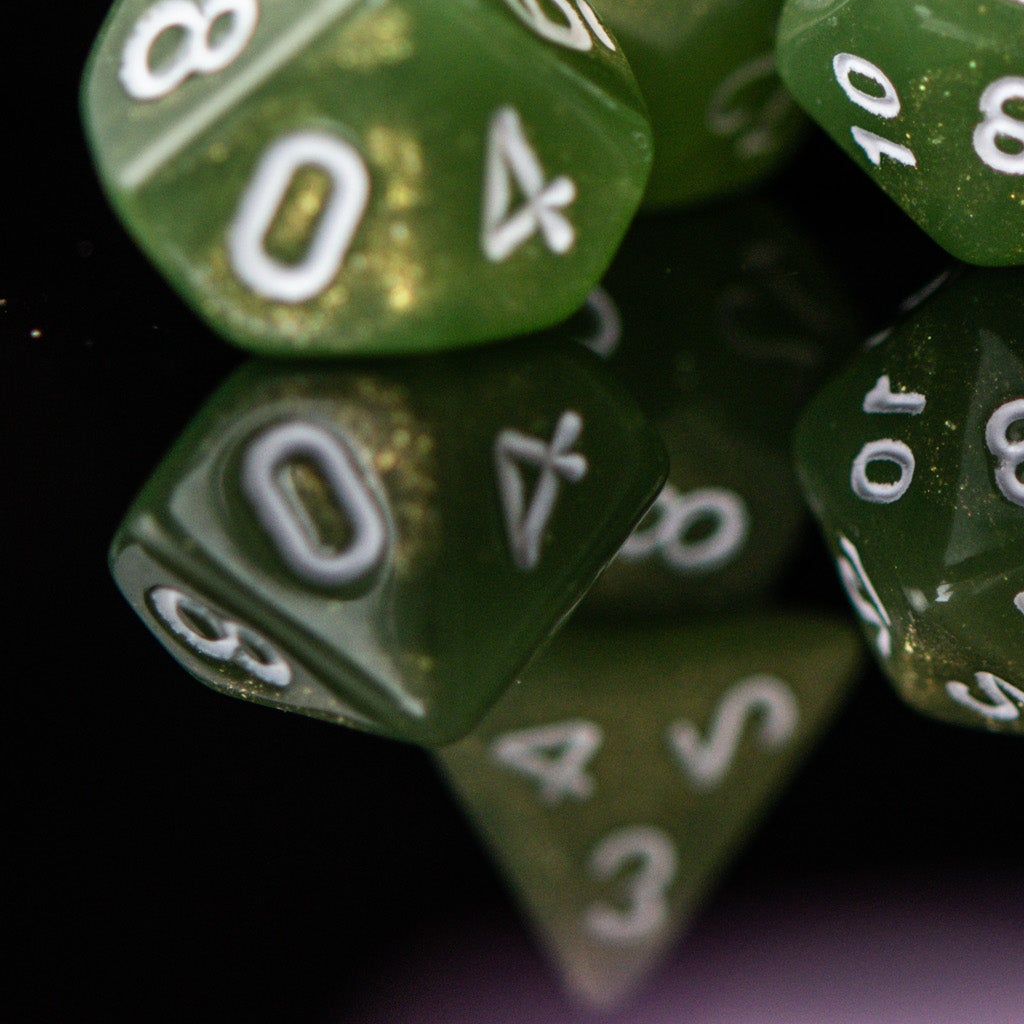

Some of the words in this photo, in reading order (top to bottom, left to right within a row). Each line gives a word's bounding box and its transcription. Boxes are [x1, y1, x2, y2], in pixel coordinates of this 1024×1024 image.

[482, 107, 577, 263] 4
[832, 51, 918, 168] 10
[228, 131, 369, 303] 0
